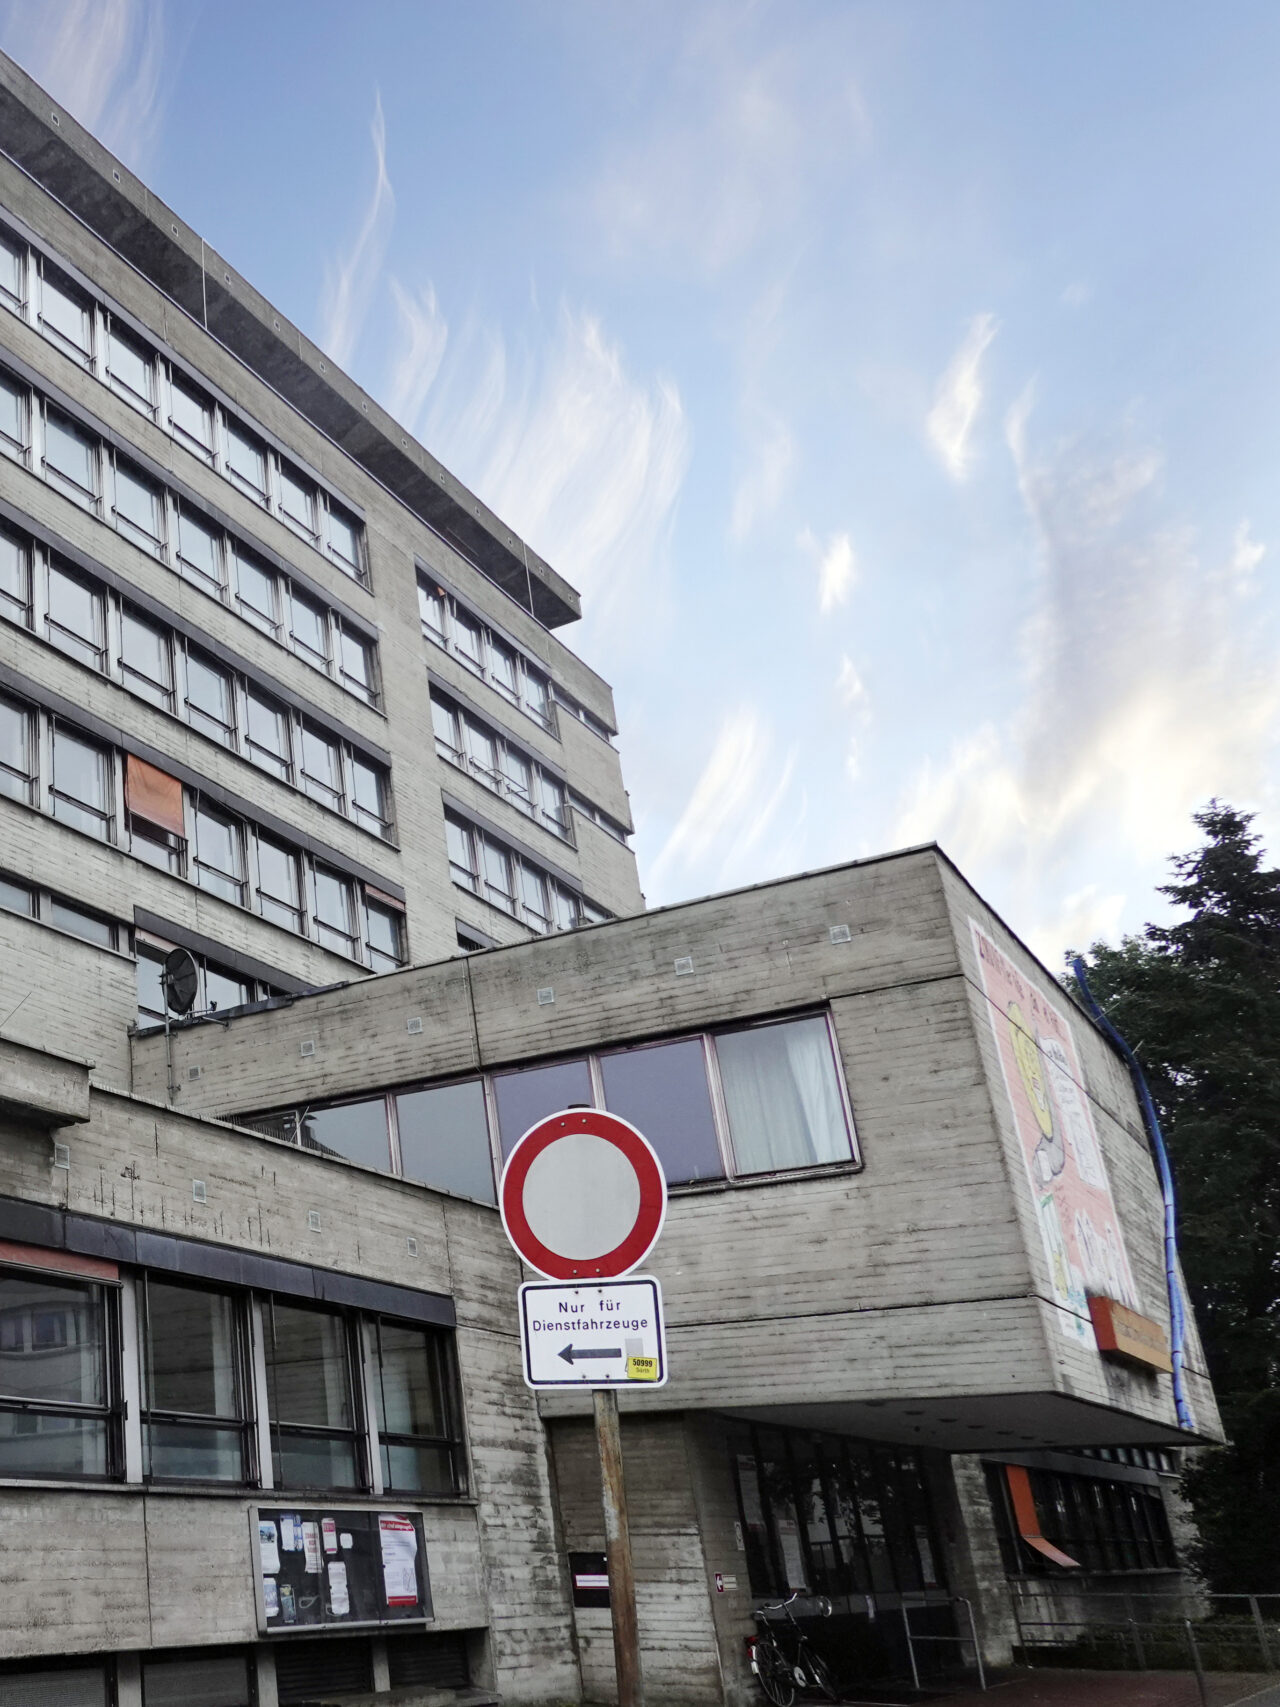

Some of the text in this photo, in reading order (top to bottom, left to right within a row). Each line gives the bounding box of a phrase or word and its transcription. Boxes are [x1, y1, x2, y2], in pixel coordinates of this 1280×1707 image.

[558, 1300, 621, 1313] Nur für
[532, 1318, 648, 1332] Dienstfahrzeuge
[632, 1358, 653, 1368] 50999
